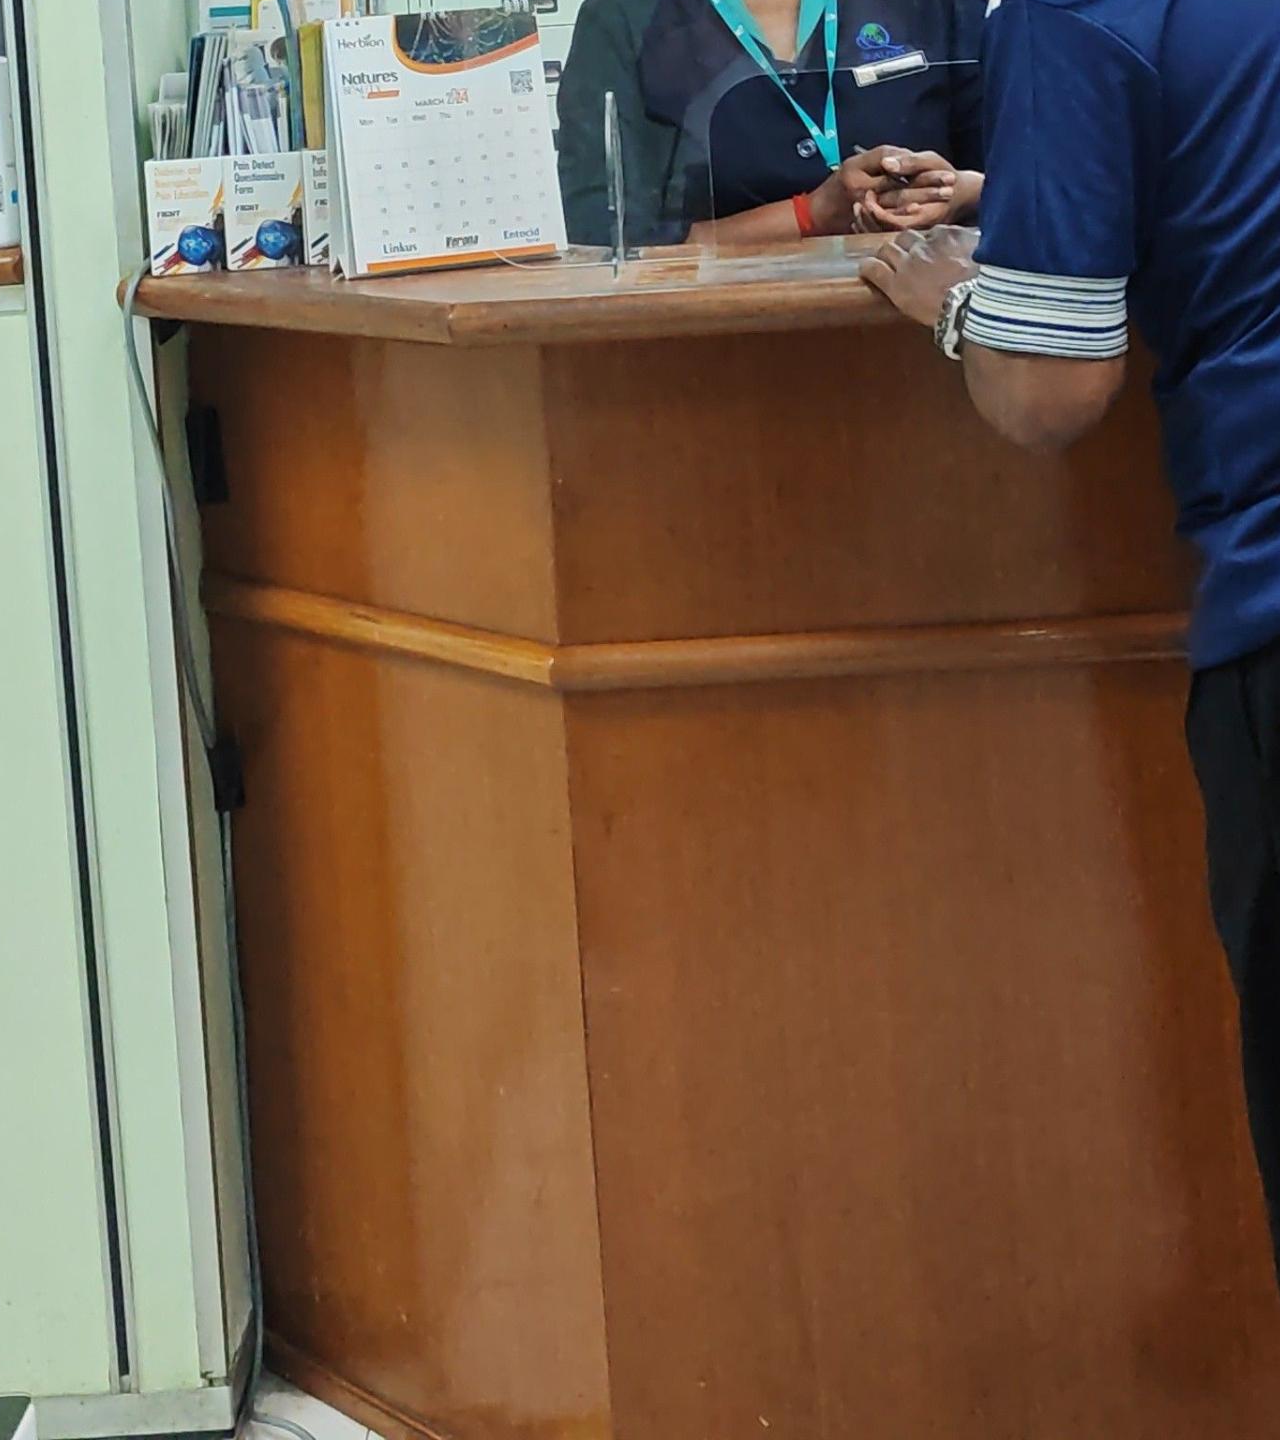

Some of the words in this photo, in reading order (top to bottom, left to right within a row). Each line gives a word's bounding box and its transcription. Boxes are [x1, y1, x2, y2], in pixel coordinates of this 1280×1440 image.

[337, 34, 385, 49] Herbion
[341, 71, 399, 85] Natures
[233, 160, 250, 171] Pain
[252, 160, 275, 170] Detect
[235, 185, 253, 195] Form
[383, 242, 417, 254] Linkus
